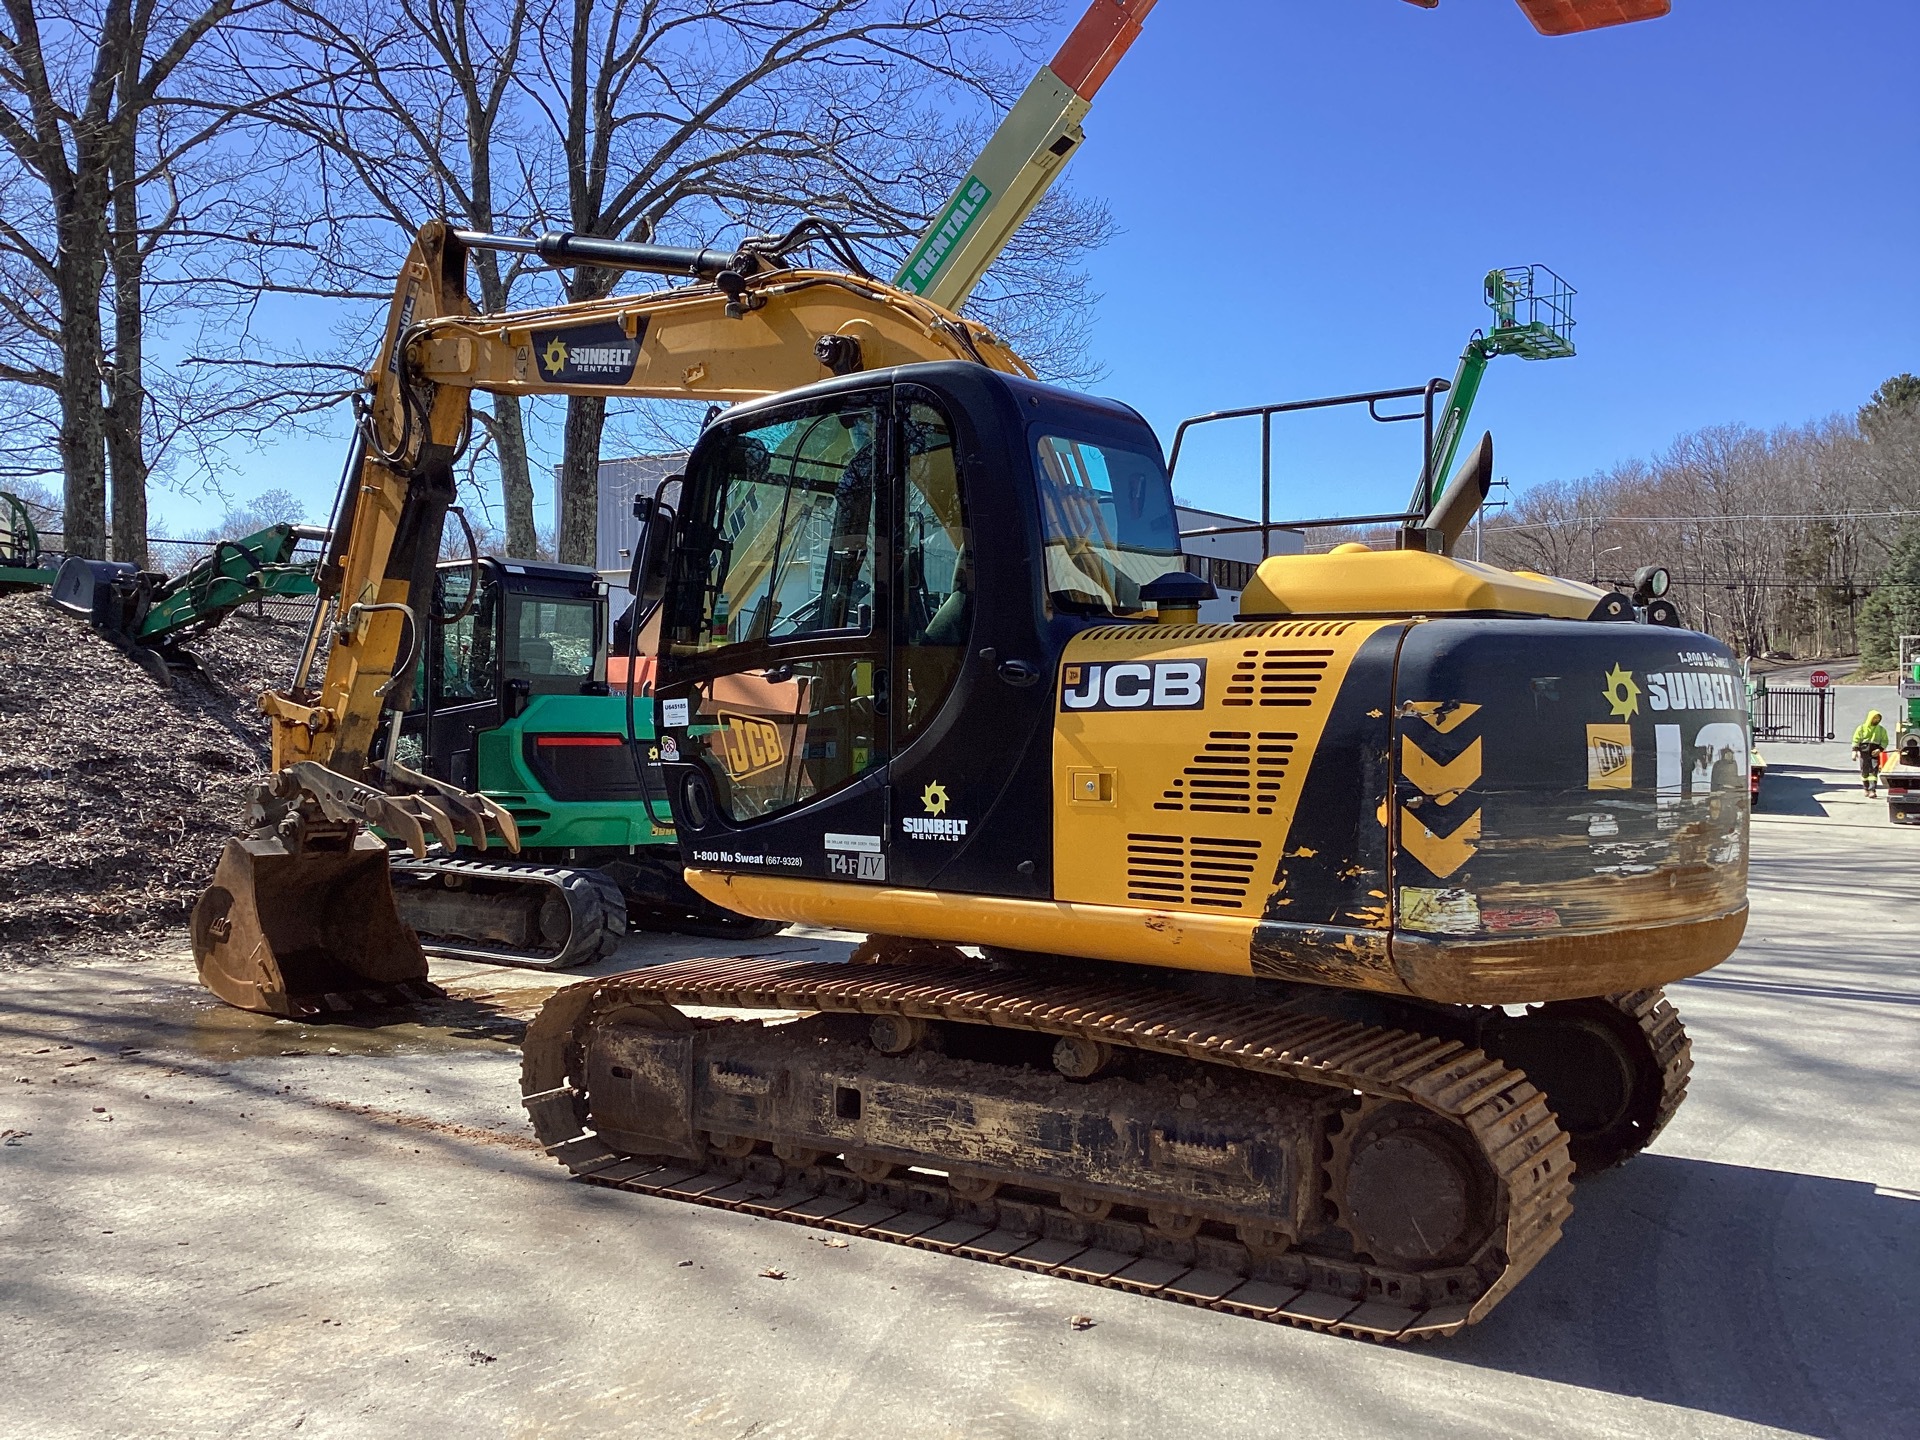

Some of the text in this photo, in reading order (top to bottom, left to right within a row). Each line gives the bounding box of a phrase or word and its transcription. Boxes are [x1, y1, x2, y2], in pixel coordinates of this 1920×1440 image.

[913, 182, 987, 281] RENTALS
[570, 348, 631, 366] SUNBELT
[1677, 652, 1703, 666] 1-800
[1064, 663, 1201, 708] JCB
[1811, 675, 1829, 683] STOP
[1647, 673, 1735, 711] SUNBELT
[729, 718, 780, 772] JCB
[1600, 741, 1626, 773] JCB
[903, 817, 968, 835] SUNBELT
[912, 833, 959, 841] RENTALS
[693, 851, 802, 867] 1-800 No Sweat (667-9328)
